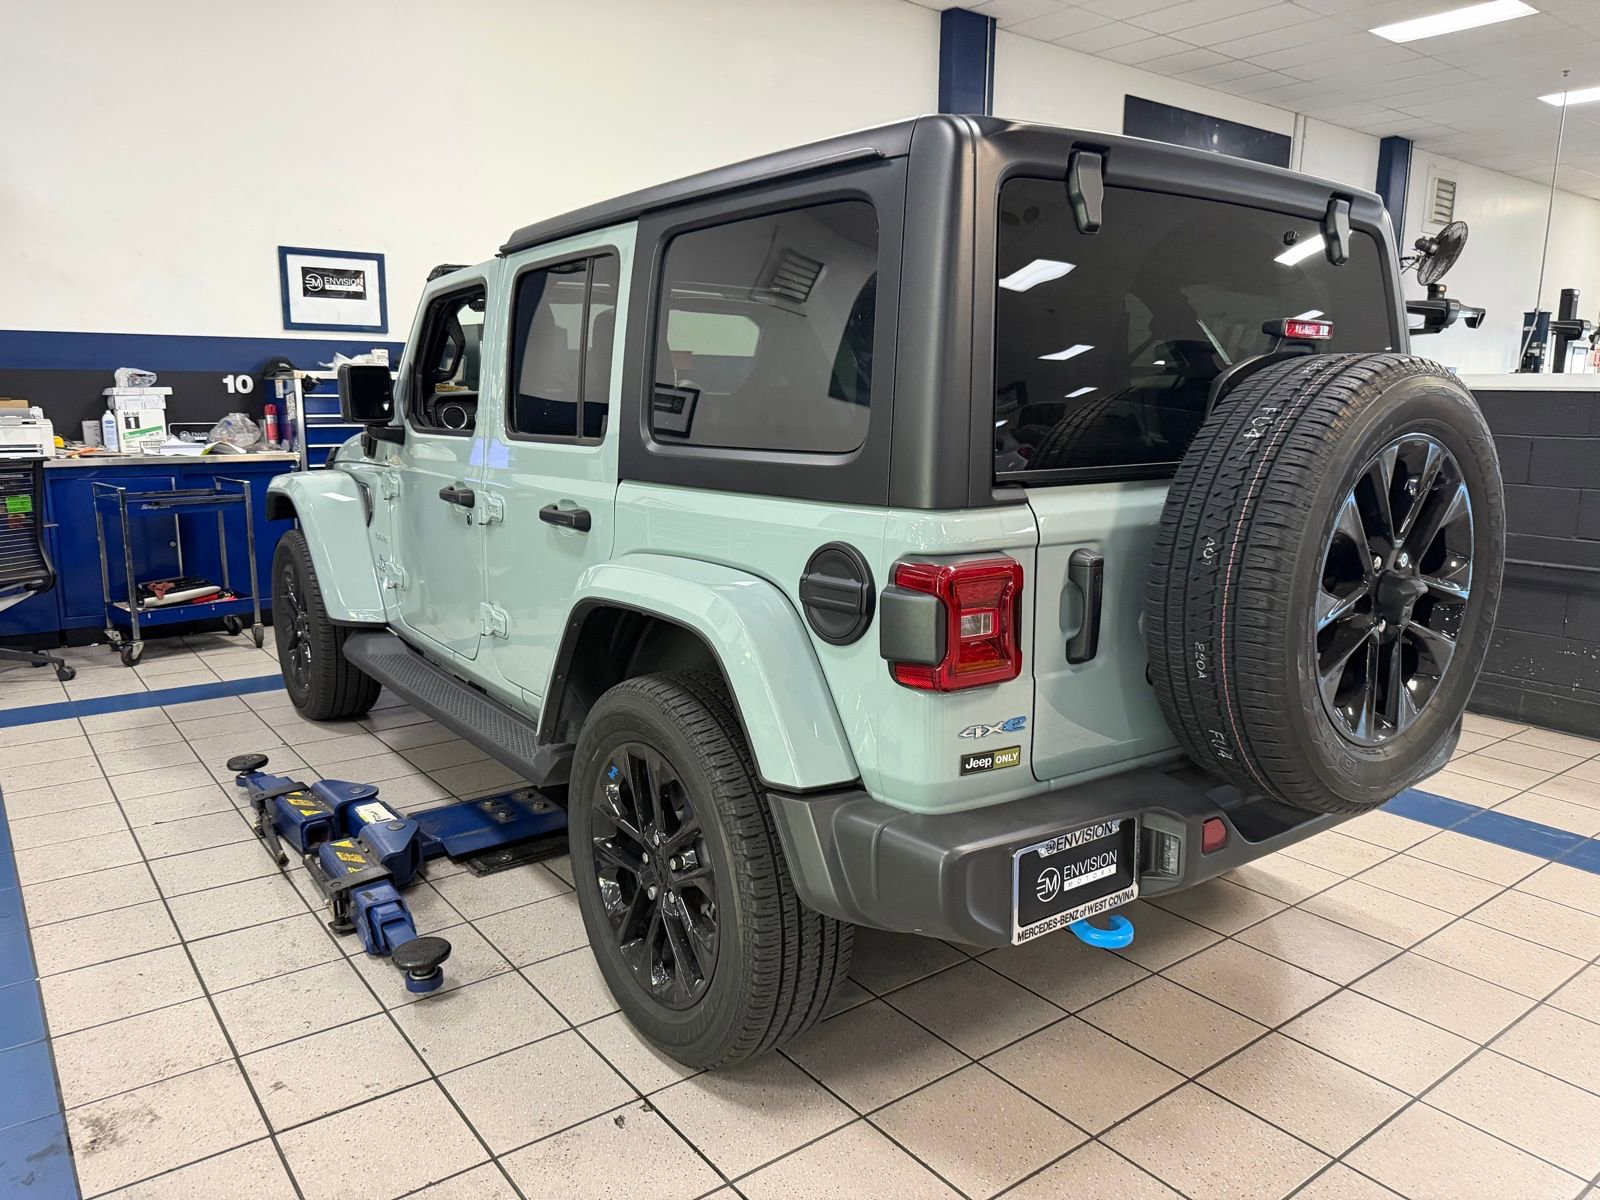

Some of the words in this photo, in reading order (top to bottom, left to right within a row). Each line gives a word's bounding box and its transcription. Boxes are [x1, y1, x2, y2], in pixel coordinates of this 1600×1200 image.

[222, 374, 254, 394] 10
[965, 758, 992, 769] Jeep
[995, 752, 1018, 764] ONLY
[1056, 821, 1113, 851] ENVISION
[1064, 849, 1118, 880] ENVISION
[1067, 868, 1112, 888] MOTORS
[1017, 909, 1079, 942] MERCEDES-BENZ
[1079, 907, 1088, 918] of
[1088, 898, 1108, 915] WEST
[1108, 889, 1135, 907] COVINA
